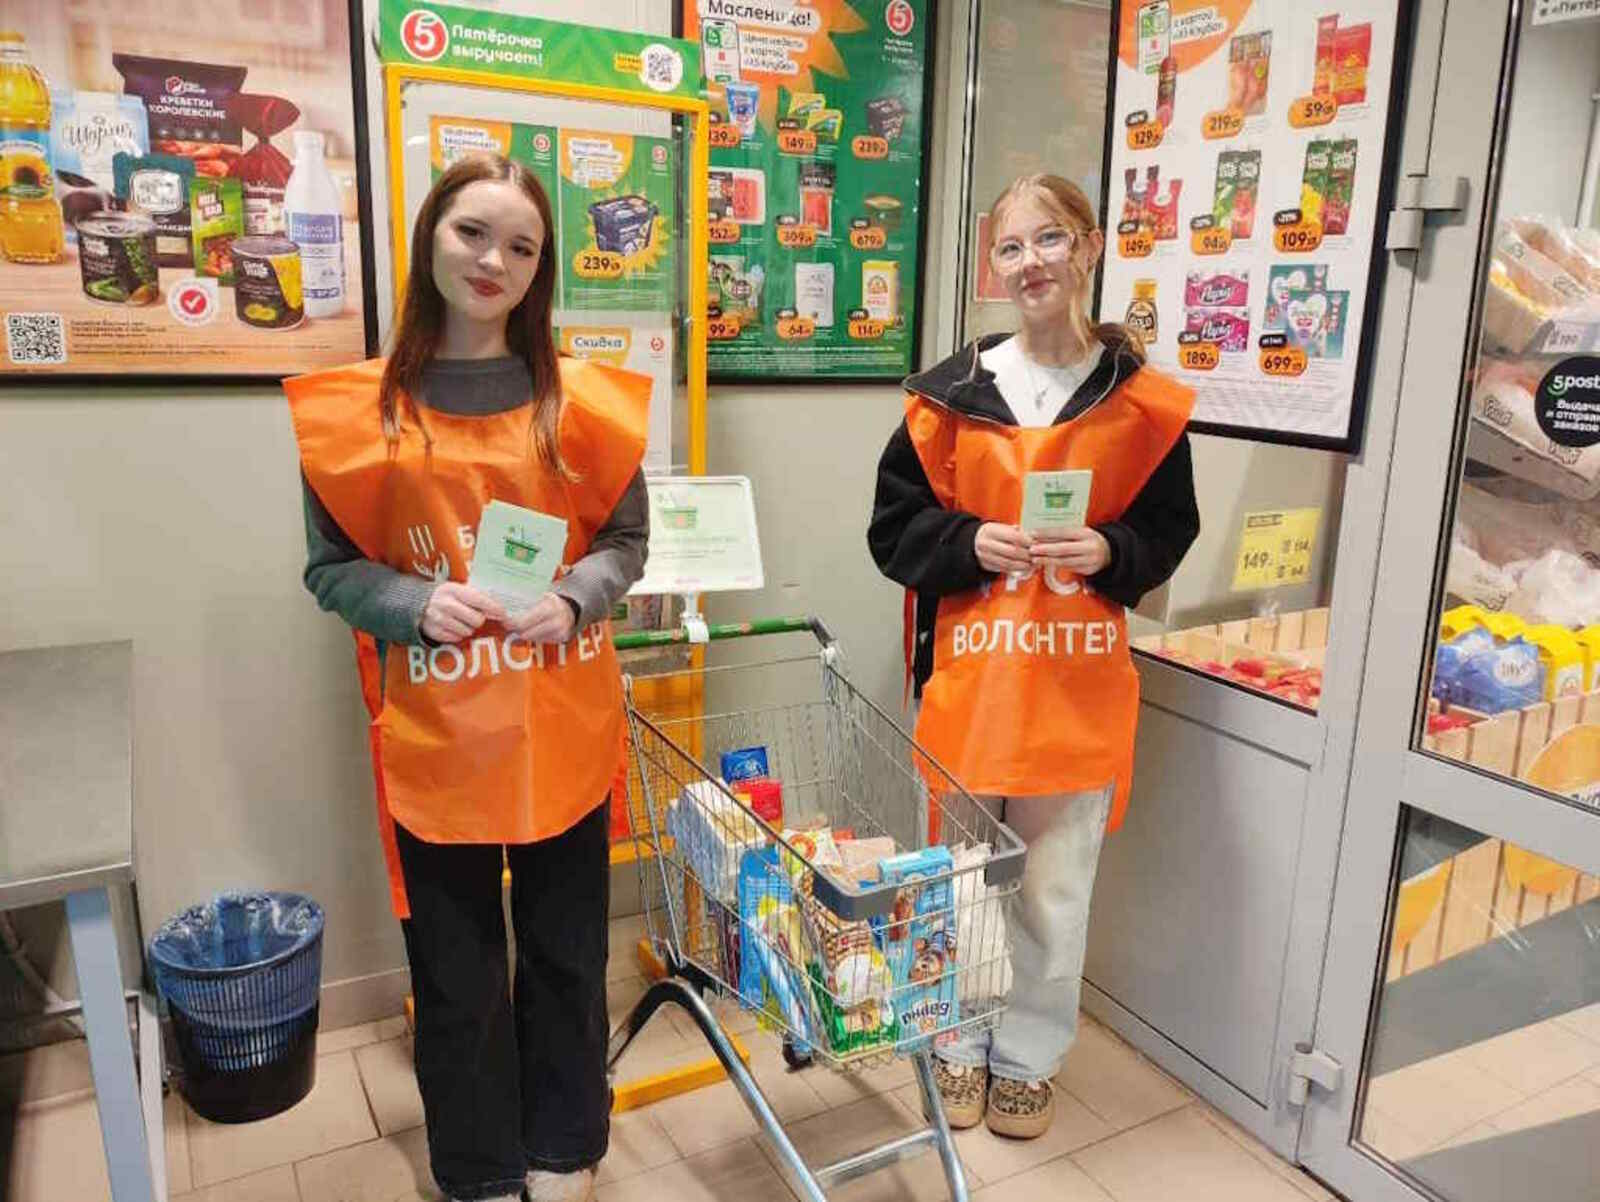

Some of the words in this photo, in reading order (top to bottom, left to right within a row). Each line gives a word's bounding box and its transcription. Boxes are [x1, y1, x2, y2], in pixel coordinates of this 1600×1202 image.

[452, 24, 543, 49] Пятёрочка
[452, 44, 543, 67] выручает!
[160, 95, 214, 108] КРЕВЕТКИ
[149, 103, 226, 120] КОРОЛЕВСКИЕ
[1282, 231, 1308, 248] 109
[1264, 355, 1292, 370] 699
